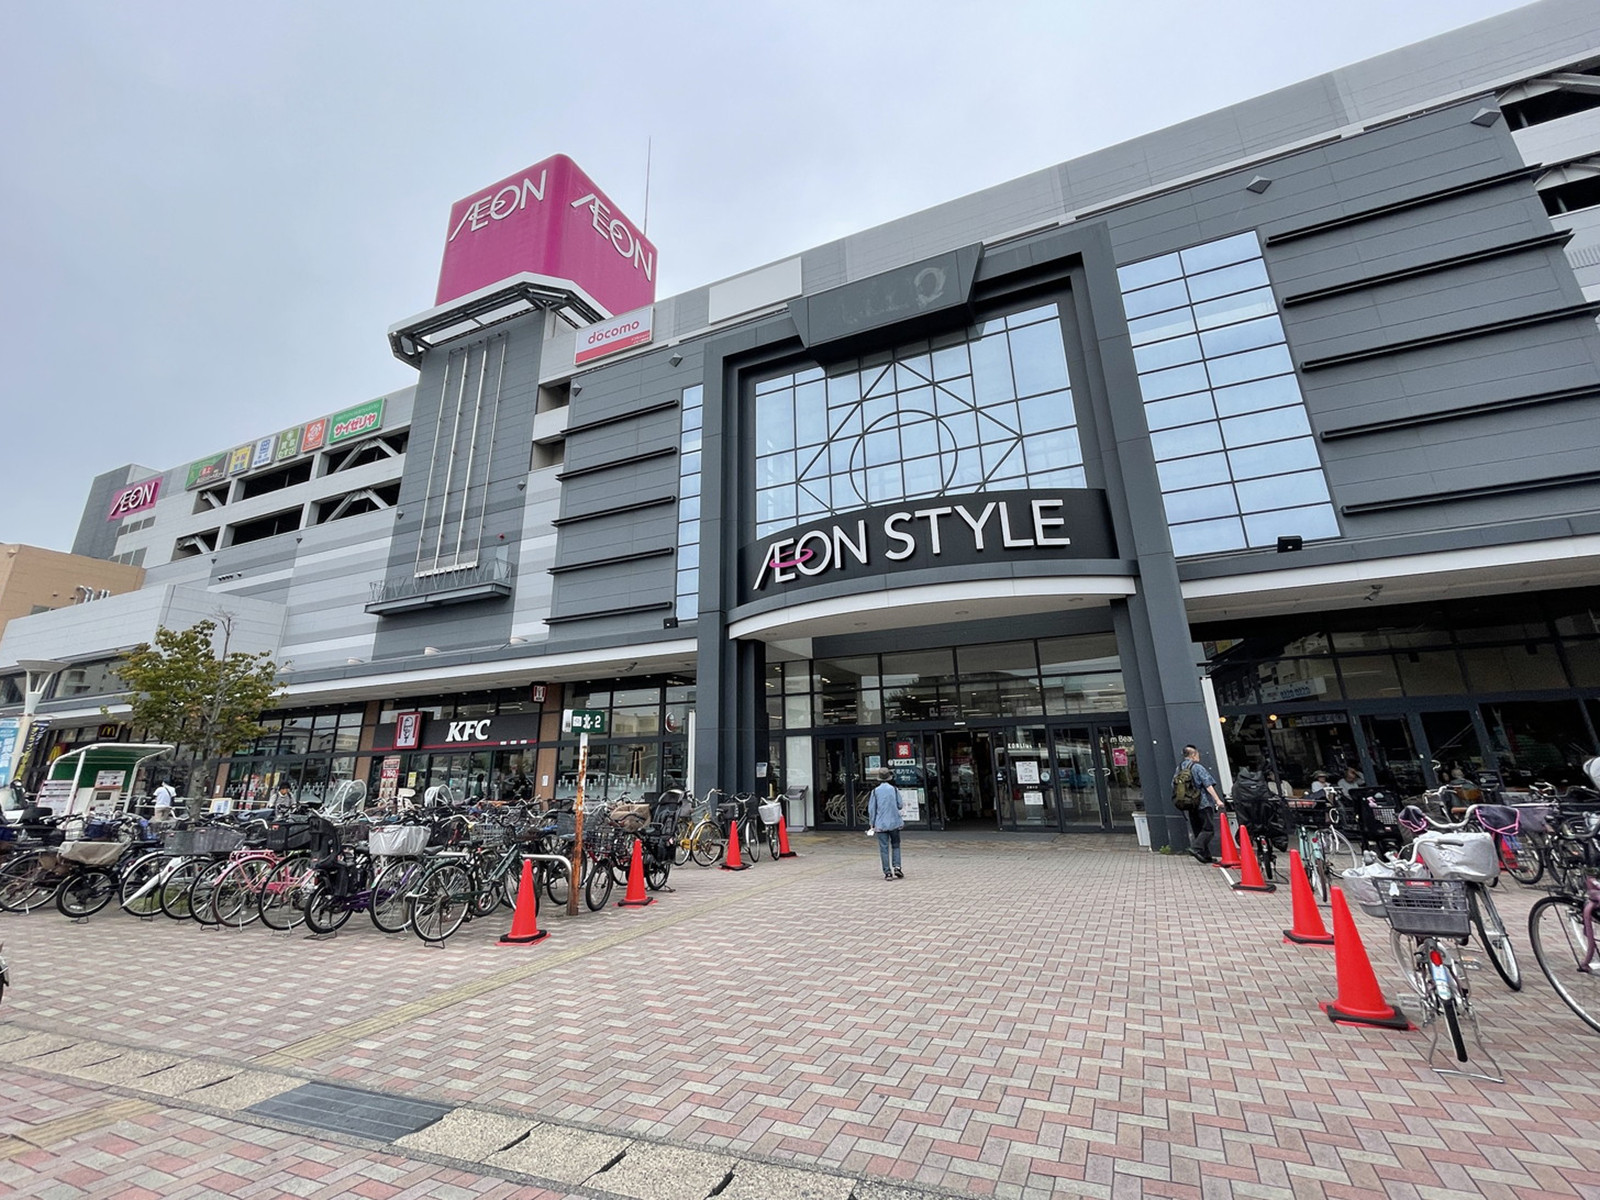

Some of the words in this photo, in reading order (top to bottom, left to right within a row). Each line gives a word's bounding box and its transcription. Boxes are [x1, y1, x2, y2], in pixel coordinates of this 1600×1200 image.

[588, 321, 640, 344] docomo
[334, 413, 377, 437] サイゼリヤ
[752, 519, 868, 590] AEON
[884, 499, 1072, 561] STYLE
[445, 719, 491, 742] KFC
